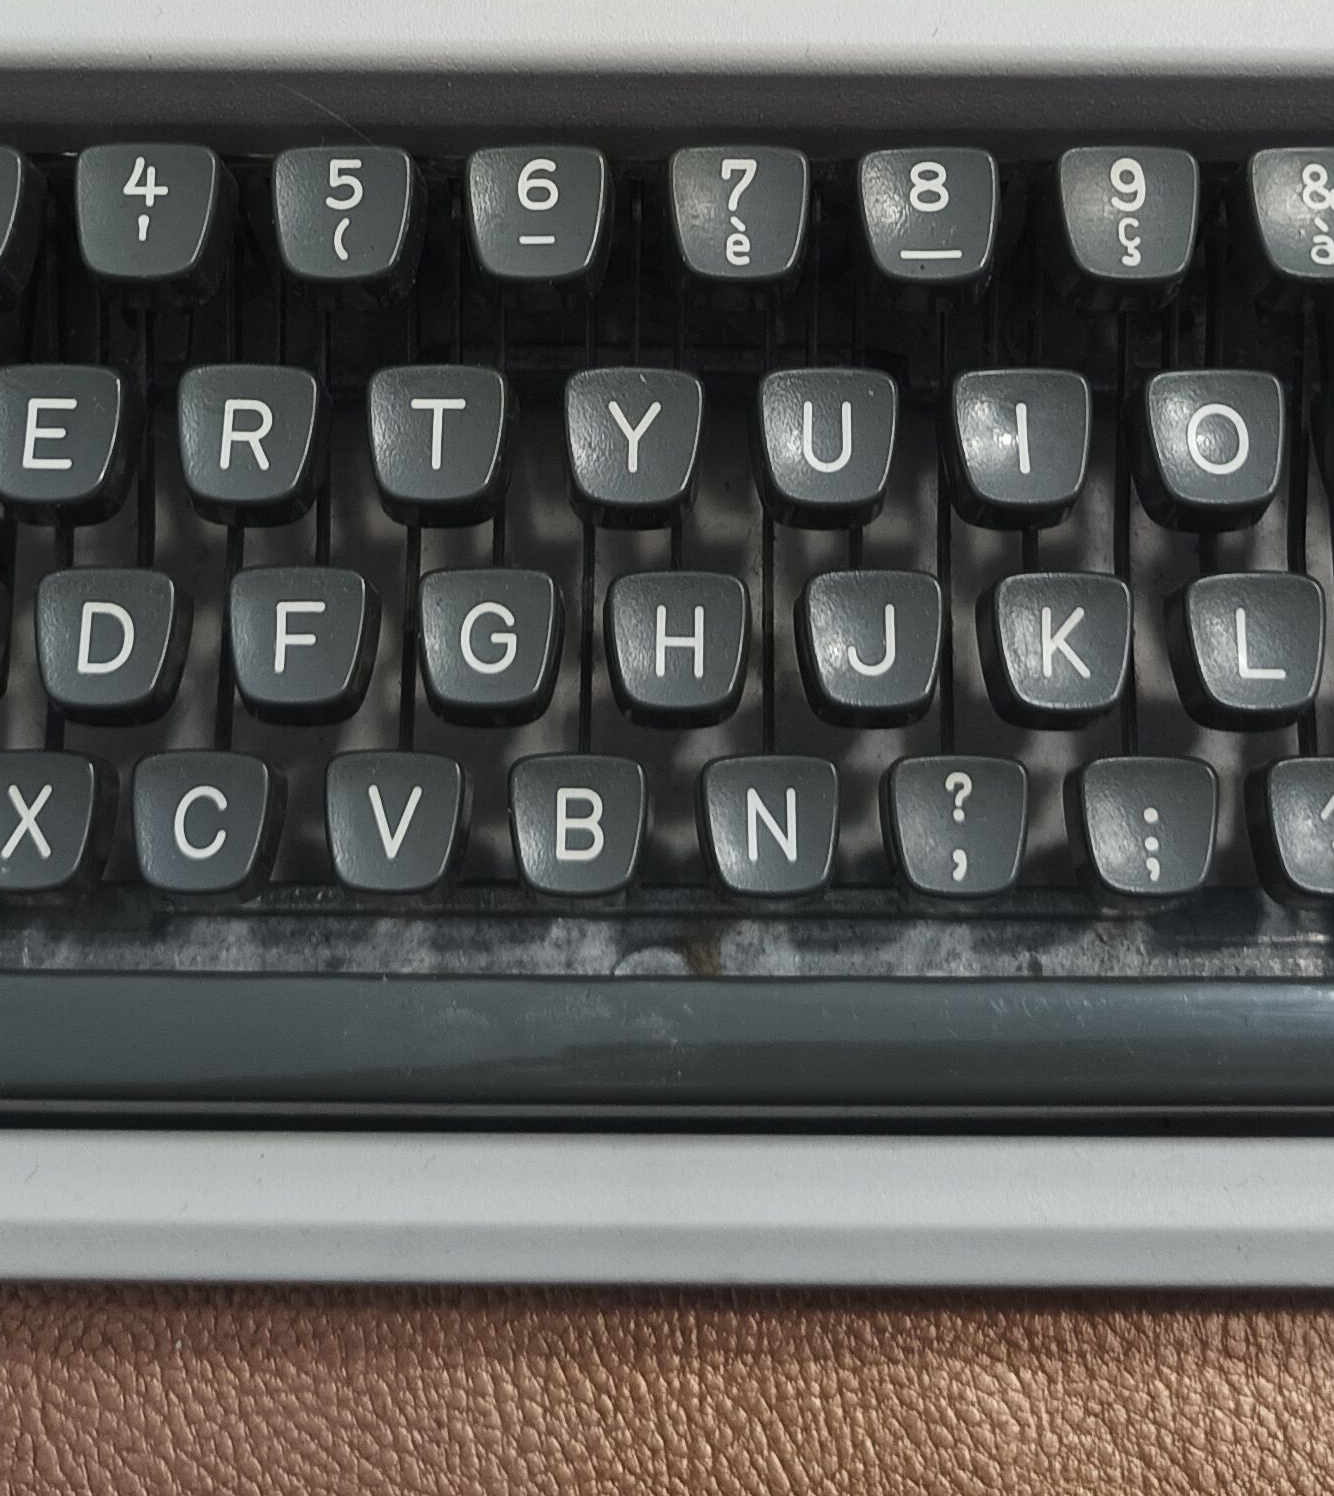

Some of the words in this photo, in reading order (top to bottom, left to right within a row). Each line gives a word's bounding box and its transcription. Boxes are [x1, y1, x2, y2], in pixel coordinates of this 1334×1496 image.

[123, 157, 169, 207] 4
[325, 159, 363, 210] 5
[517, 158, 559, 211] 6
[721, 159, 757, 211] 7
[909, 161, 949, 212] 8
[1110, 158, 1146, 212] 9
[726, 216, 751, 266] è
[1118, 217, 1141, 266] ç
[22, 398, 78, 469] E
[219, 399, 273, 471] R
[410, 398, 466, 470] T
[608, 401, 661, 473] Y
[798, 401, 852, 473] U
[1015, 403, 1031, 474] I
[1182, 403, 1249, 475] O
[77, 602, 135, 674] D
[274, 601, 326, 673] F
[460, 602, 517, 674] G
[655, 605, 704, 678] H
[847, 604, 896, 676] J
[1041, 607, 1091, 678] K
[1235, 608, 1286, 679] L
[1, 785, 53, 859] X
[174, 786, 228, 859] C
[368, 785, 422, 859] V
[555, 788, 604, 861] B
[747, 788, 797, 863] N
[945, 772, 972, 822] ?
